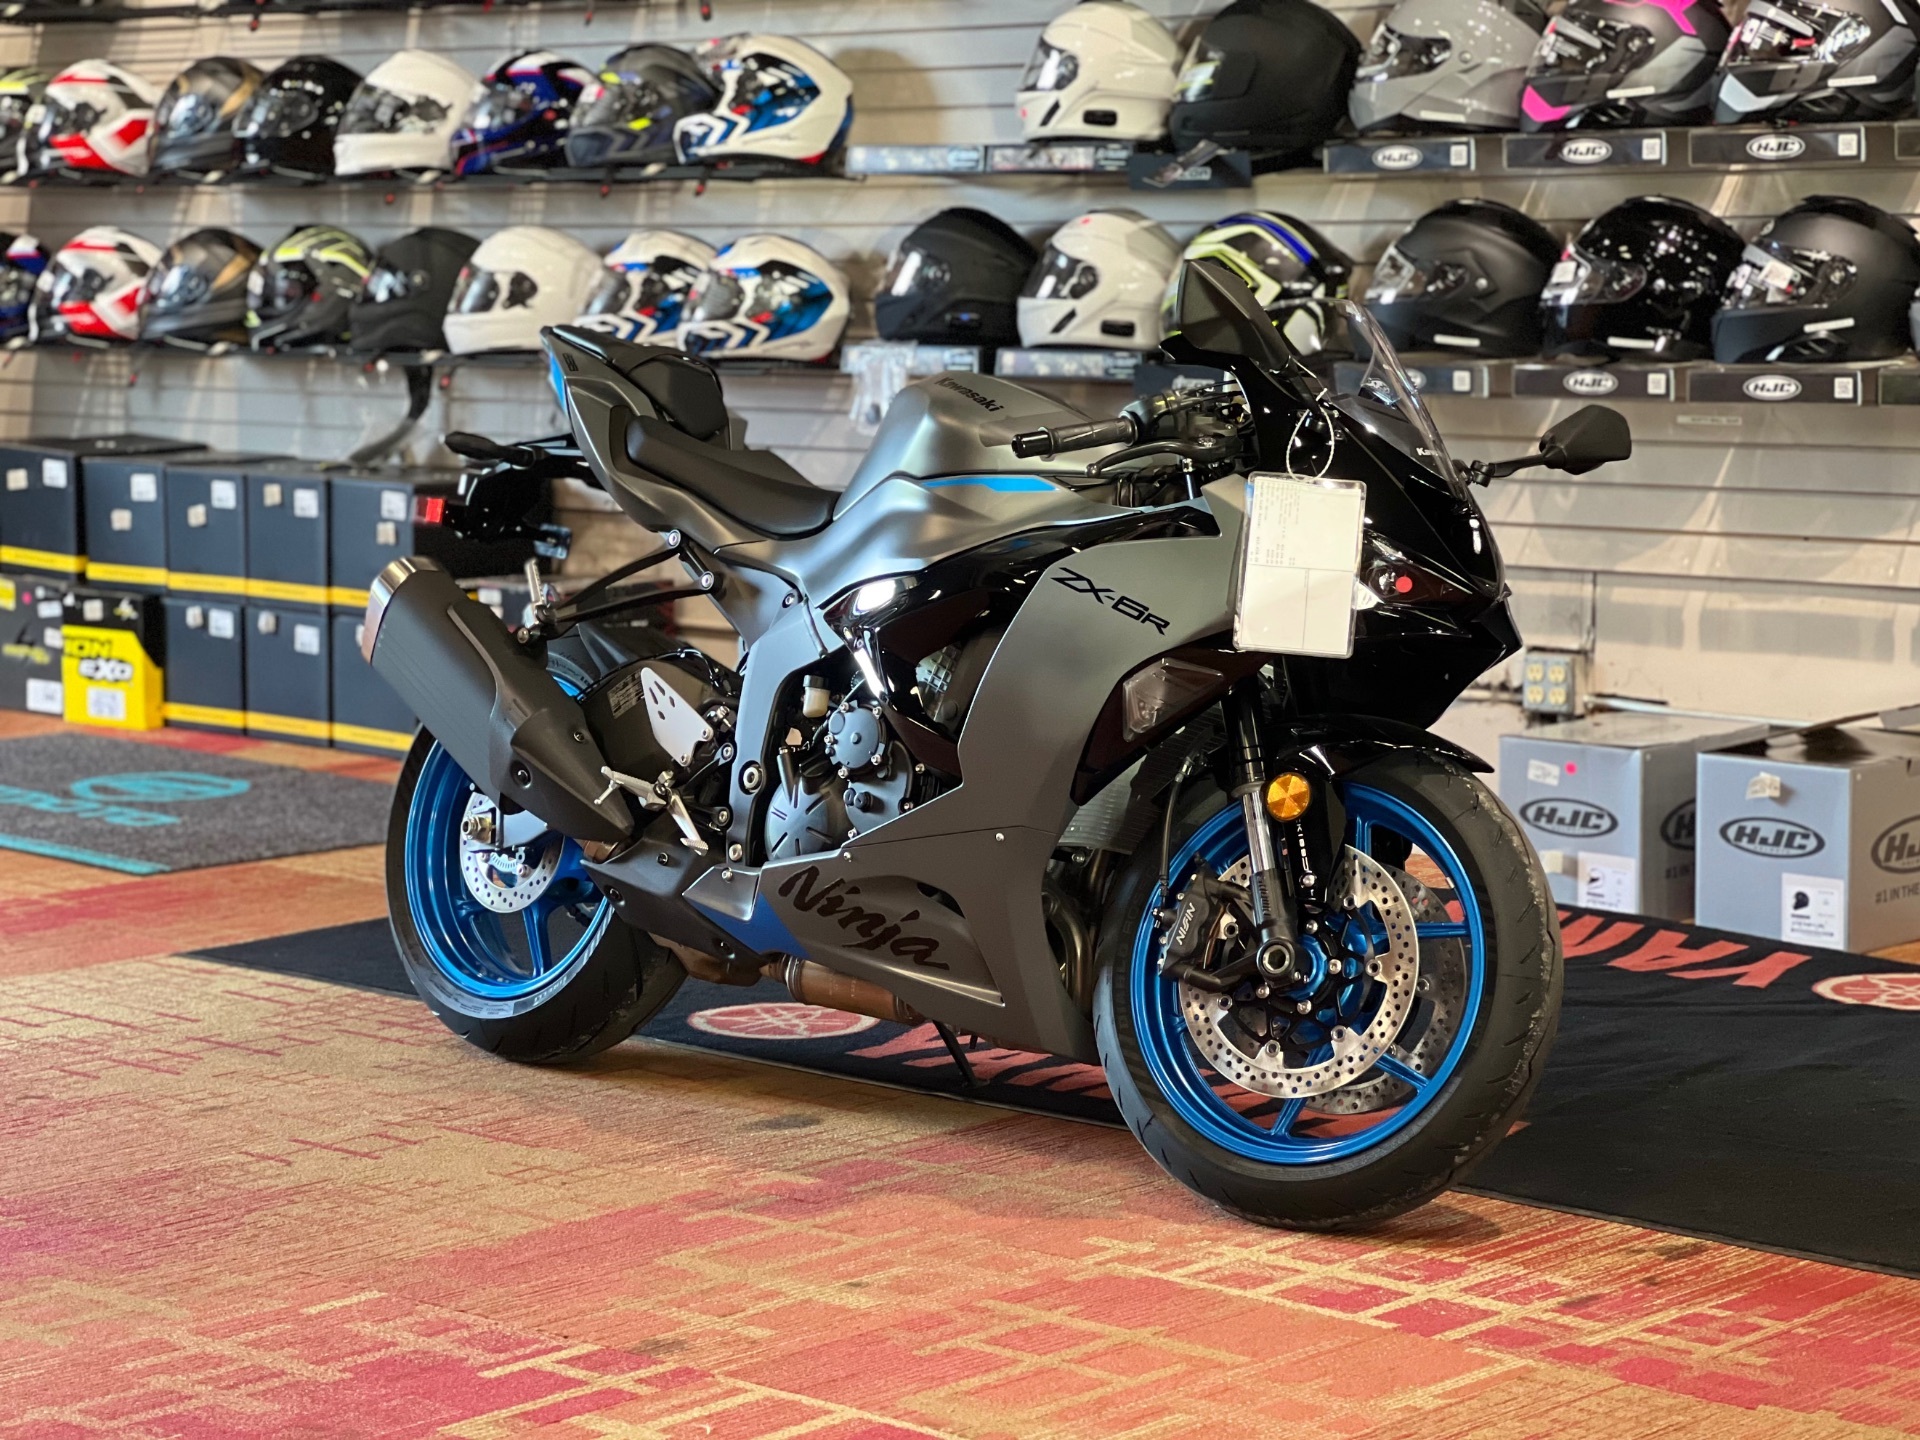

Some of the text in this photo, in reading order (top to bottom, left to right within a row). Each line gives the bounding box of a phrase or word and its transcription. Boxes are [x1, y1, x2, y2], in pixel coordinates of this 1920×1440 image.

[1567, 145, 1603, 157] HJC
[1755, 140, 1796, 152] HJC
[934, 377, 1005, 412] Kawasaki
[1573, 377, 1610, 389] HJC
[1752, 382, 1793, 393] HJC
[1050, 567, 1170, 636] ZX-6R
[79, 659, 133, 682] EXO
[1532, 805, 1605, 830] HJC
[1732, 825, 1811, 851] HJC
[1883, 832, 1920, 863] HJ
[1875, 889, 1888, 904] #1
[1889, 887, 1901, 901] IN
[778, 865, 950, 970] Ninja
[1176, 902, 1197, 946] NISSIN
